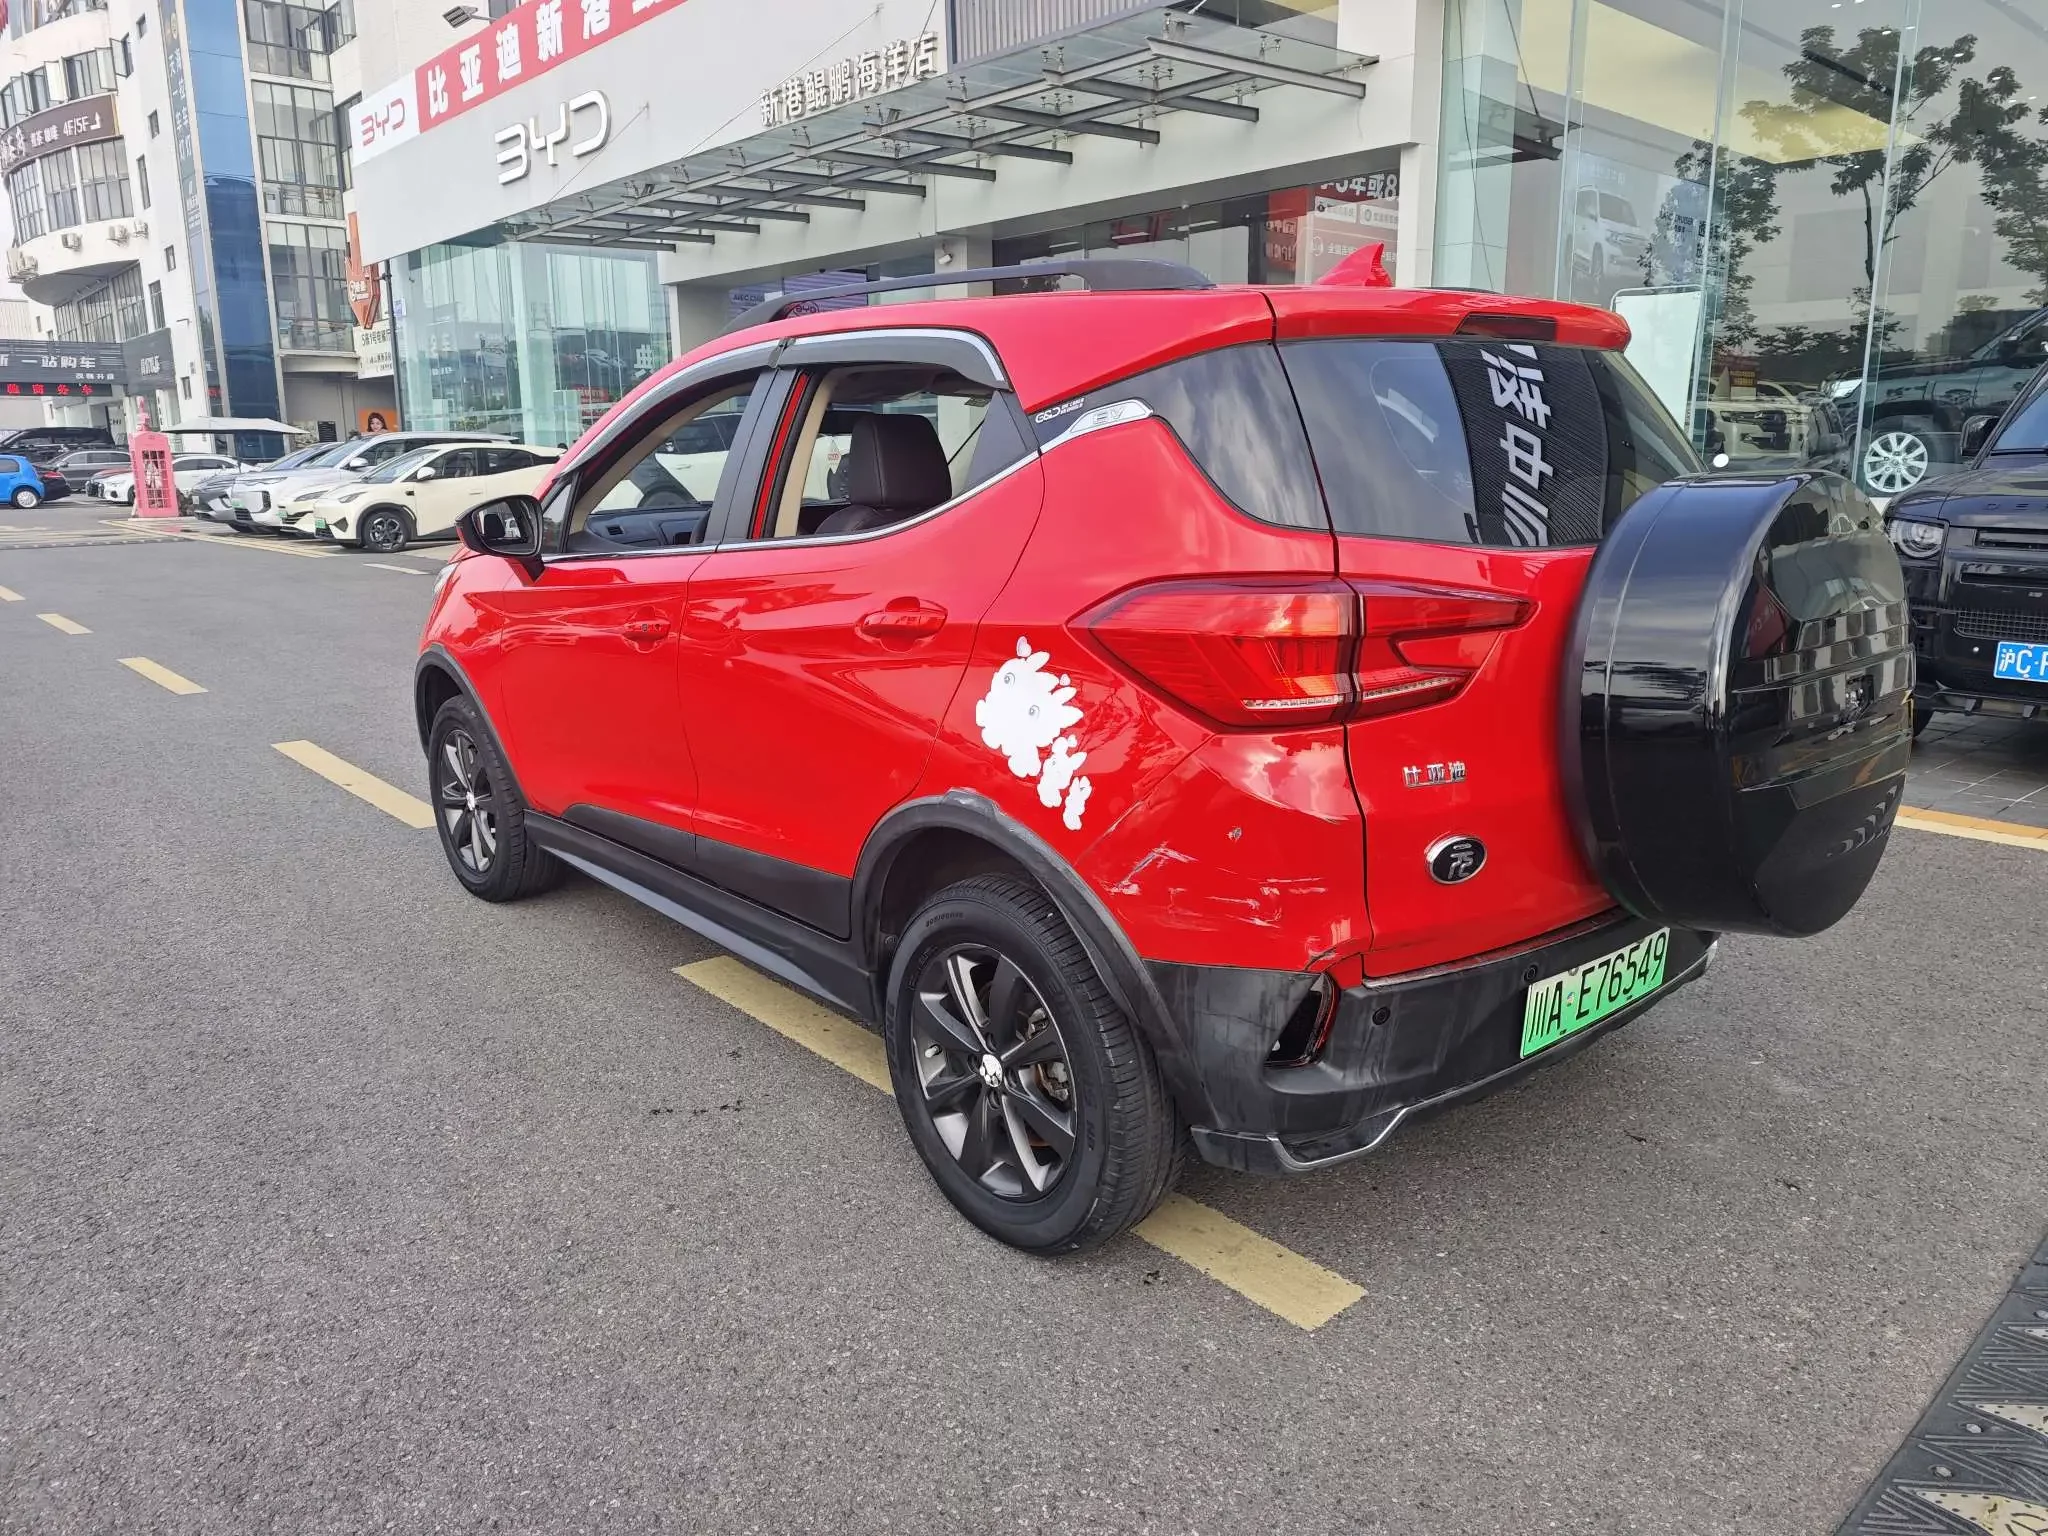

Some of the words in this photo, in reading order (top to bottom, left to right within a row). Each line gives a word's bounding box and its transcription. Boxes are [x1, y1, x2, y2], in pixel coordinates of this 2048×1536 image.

[428, 0, 664, 118] 比亚迪新港
[760, 31, 938, 127] 新港鲲鹏海洋店
[361, 98, 405, 146] BYD
[495, 89, 611, 185] BYD
[21, 355, 96, 369] 一站购车
